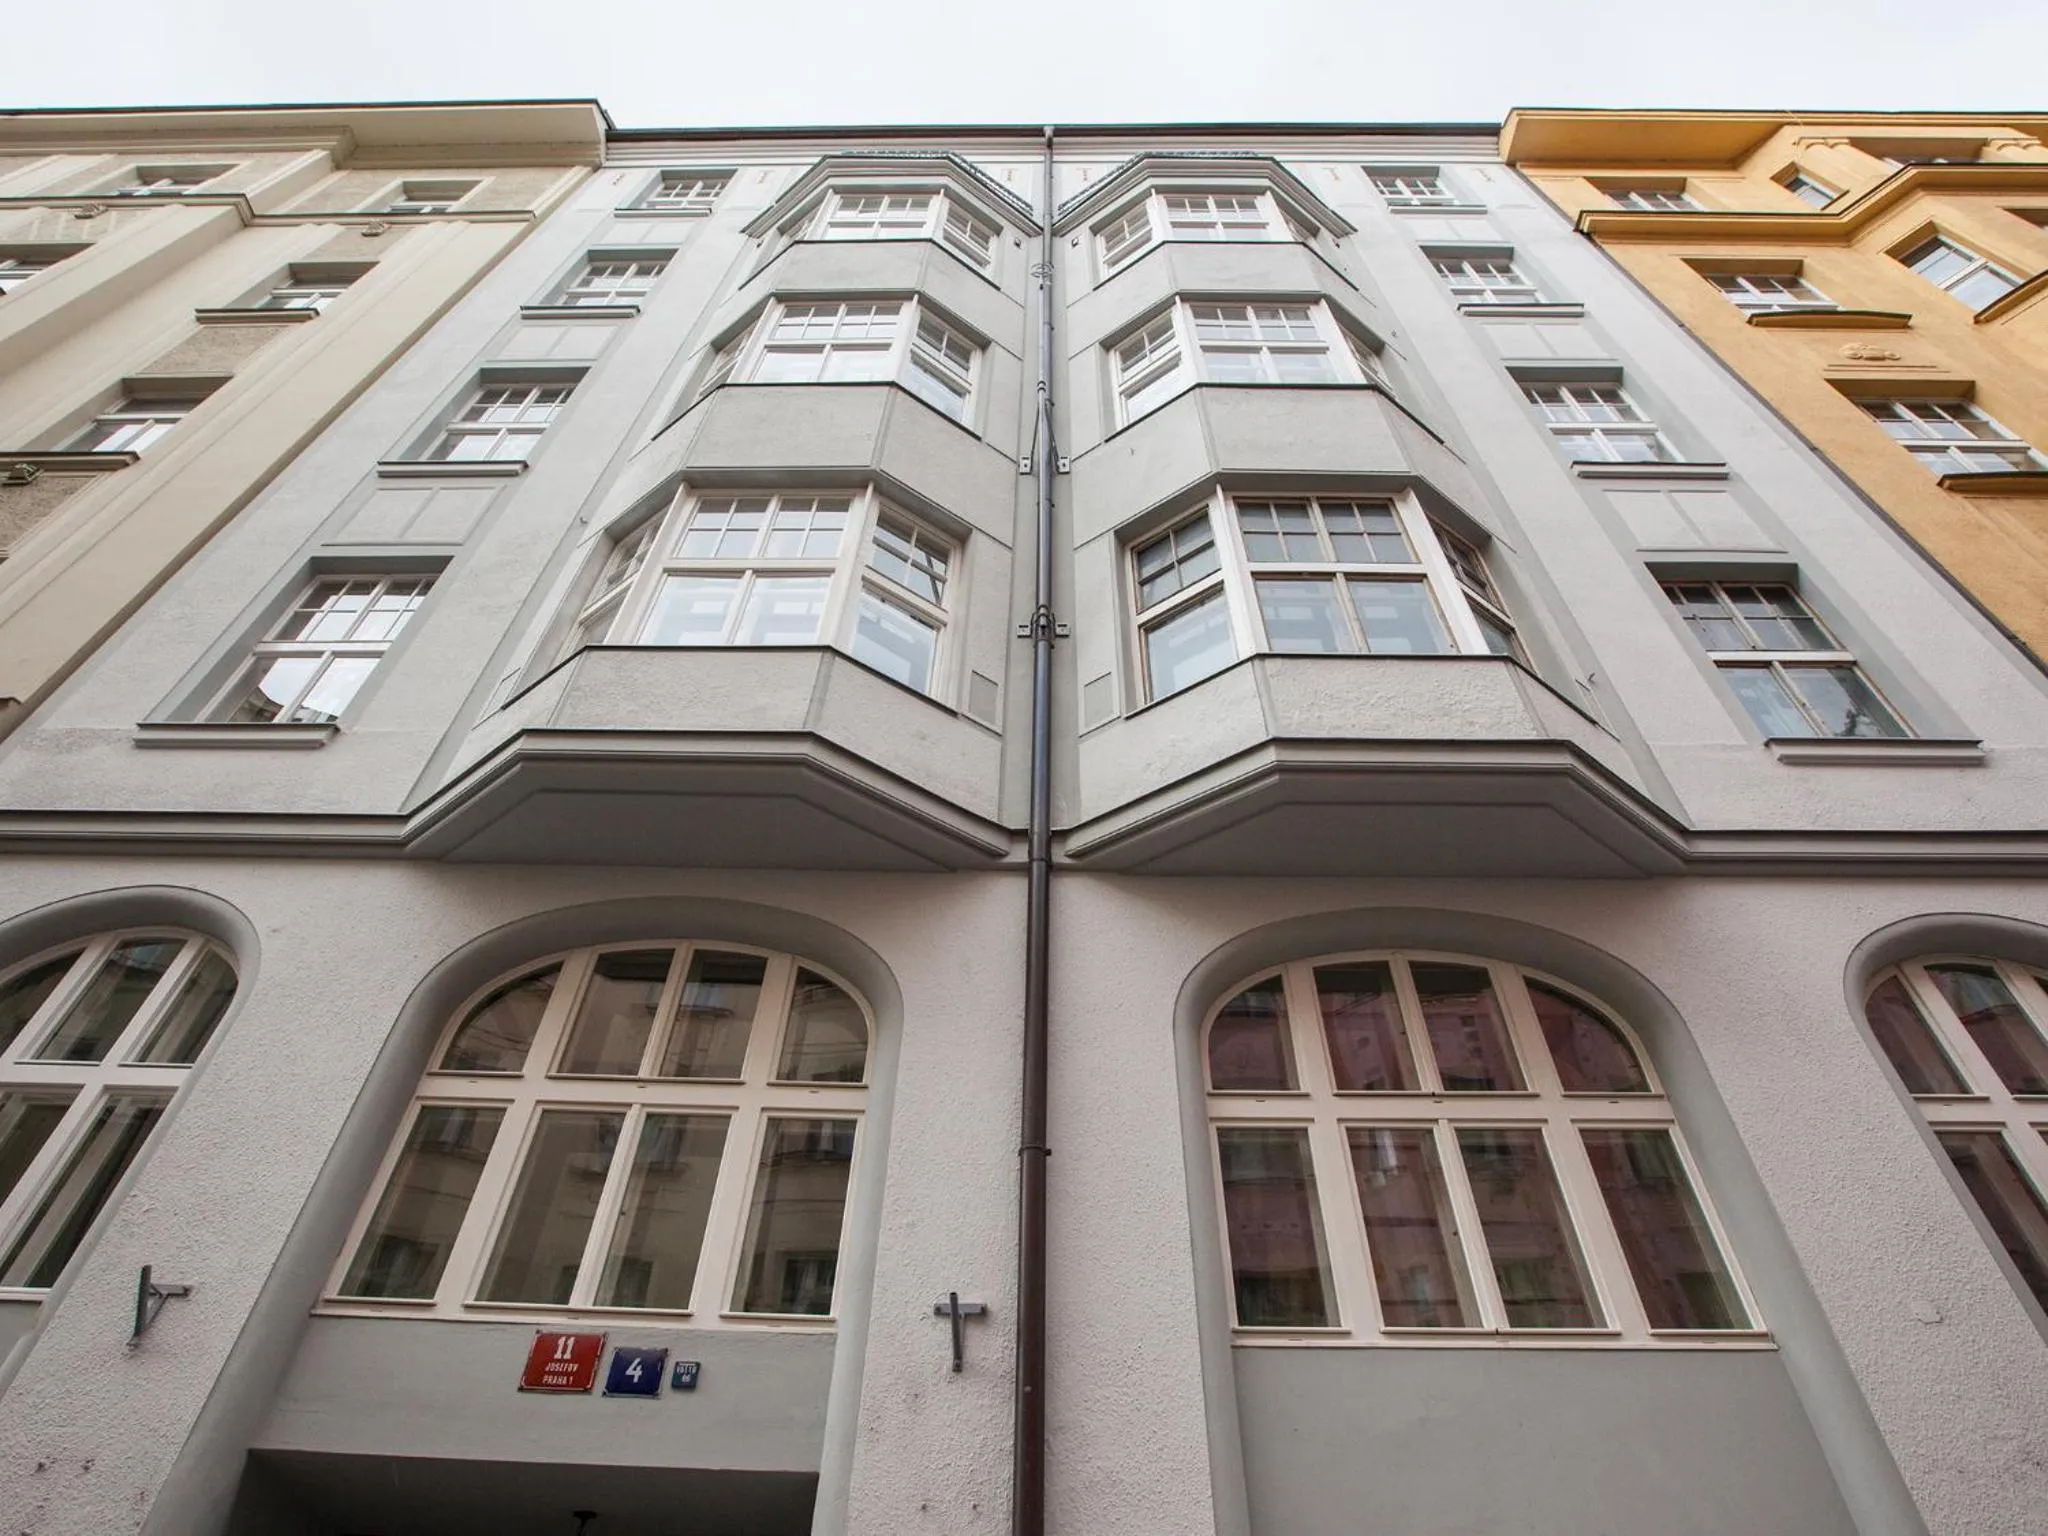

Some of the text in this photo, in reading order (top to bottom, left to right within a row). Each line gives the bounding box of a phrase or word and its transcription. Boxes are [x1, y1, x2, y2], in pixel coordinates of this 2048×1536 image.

[554, 1336, 575, 1359] 11
[545, 1362, 579, 1373] JOSEFOV
[625, 1357, 643, 1383] 4
[542, 1374, 574, 1385] PRAHA 1
